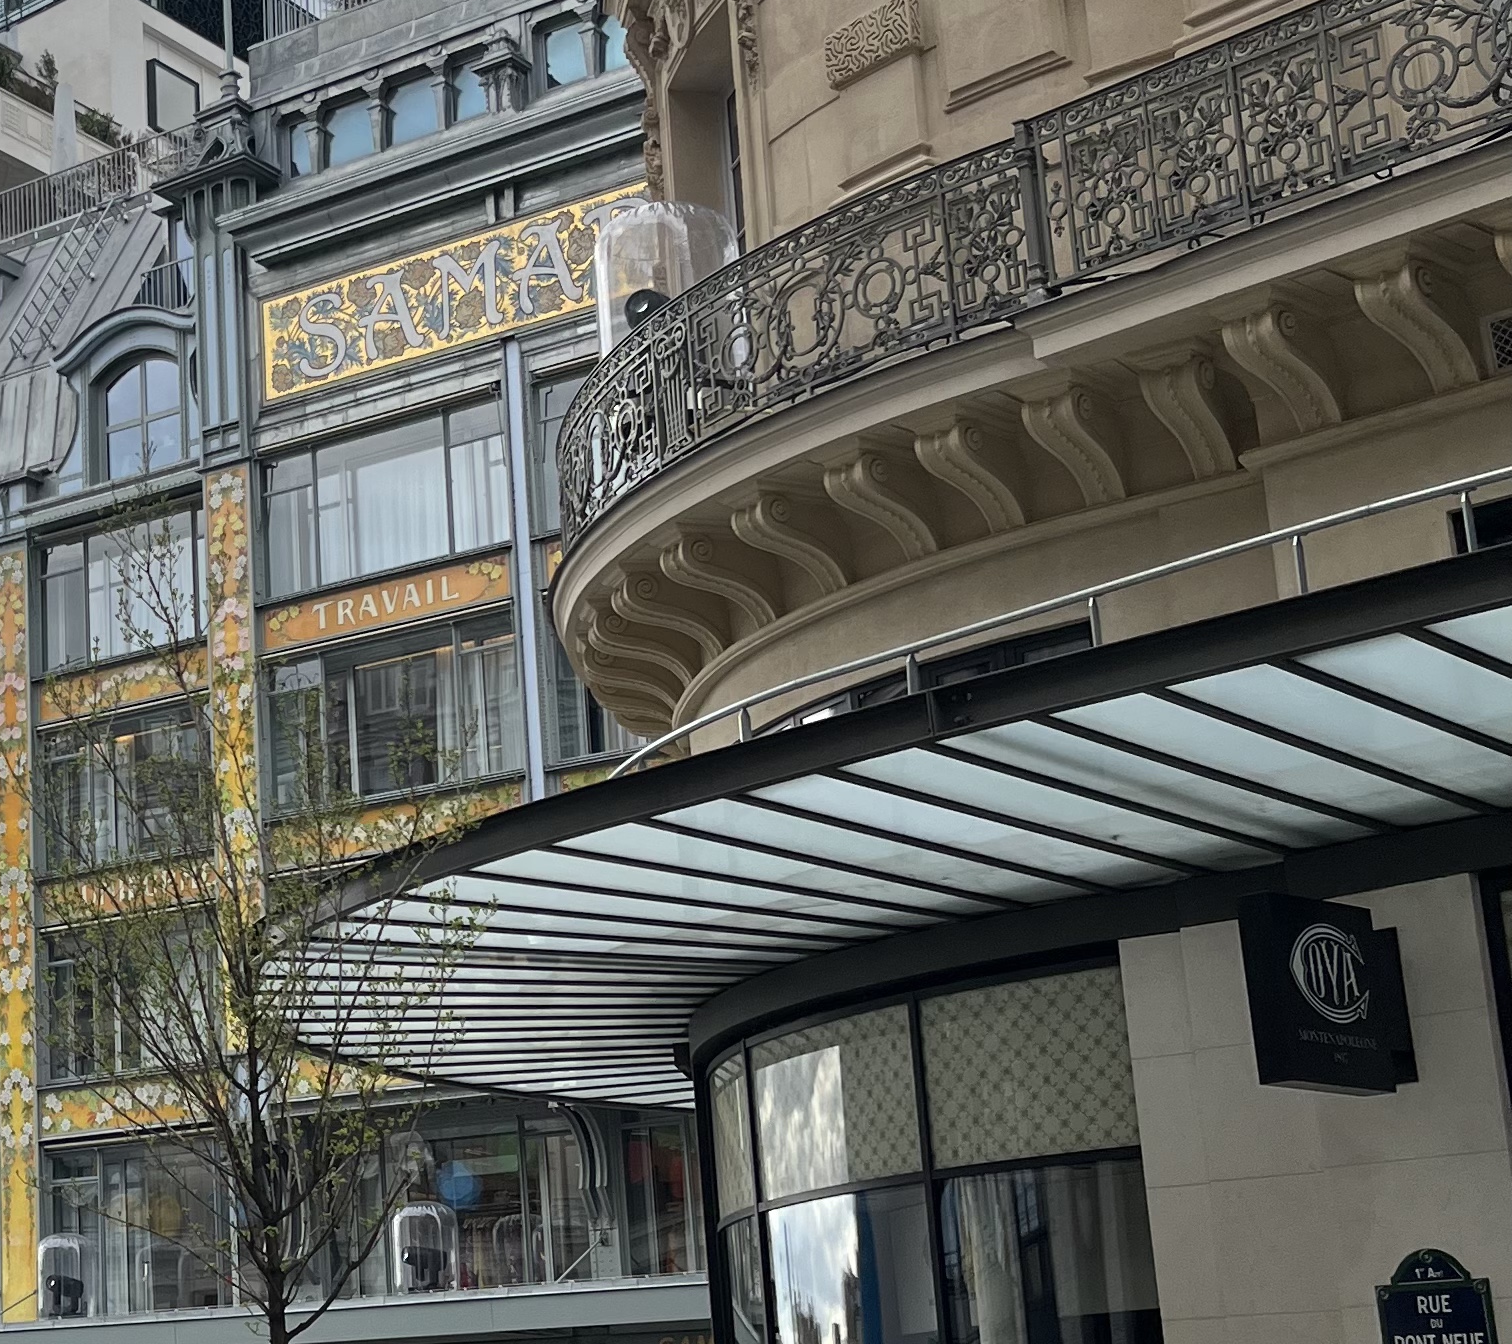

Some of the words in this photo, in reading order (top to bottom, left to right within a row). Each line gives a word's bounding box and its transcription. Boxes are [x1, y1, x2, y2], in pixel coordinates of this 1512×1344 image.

[311, 575, 460, 630] TRAVAIL
[1416, 1294, 1453, 1314] RUE
[1430, 1318, 1444, 1328] DU
